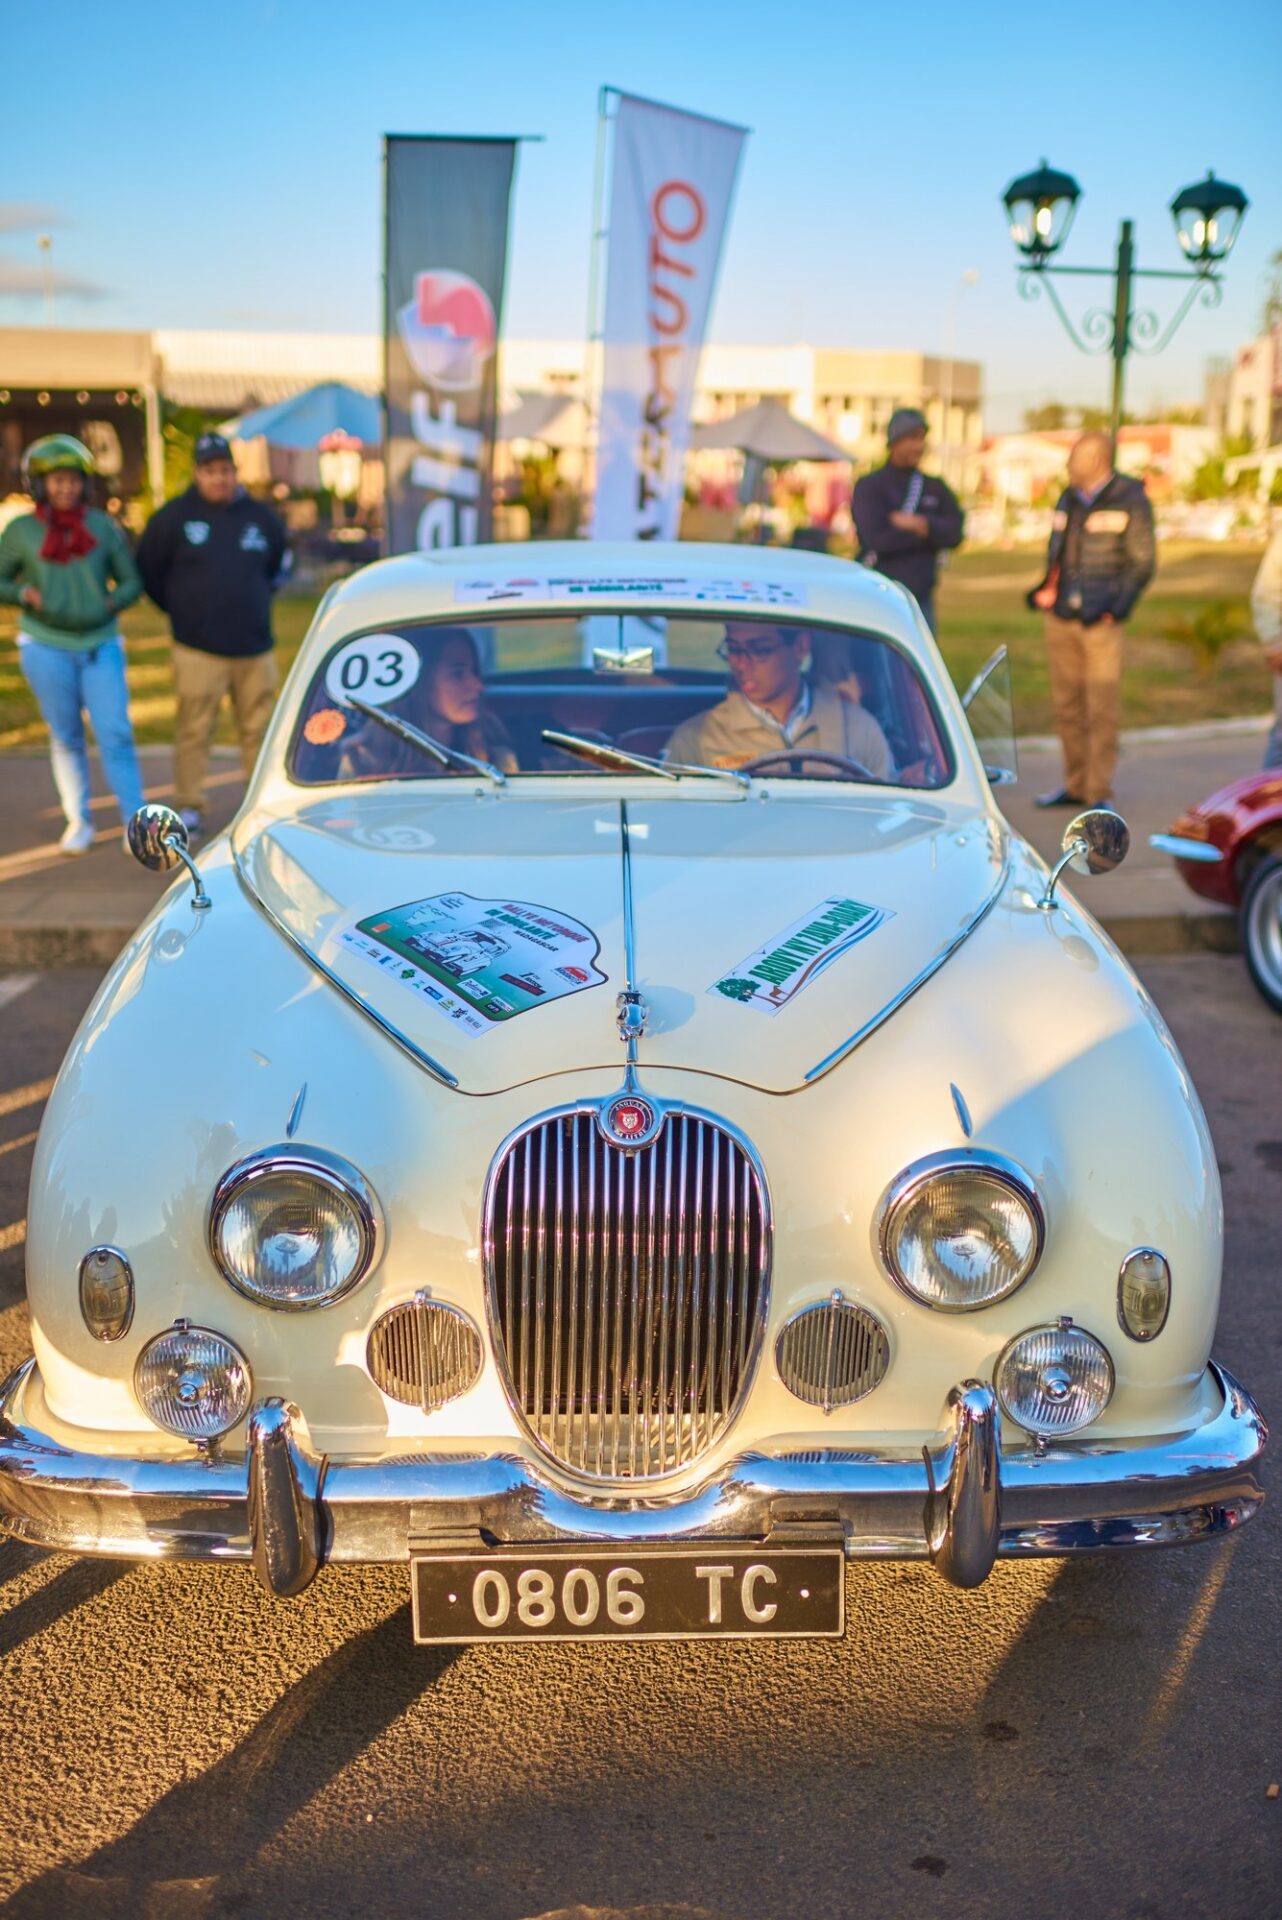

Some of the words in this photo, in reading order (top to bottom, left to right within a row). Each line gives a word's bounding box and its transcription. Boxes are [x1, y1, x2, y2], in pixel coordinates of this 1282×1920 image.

[411, 390, 483, 551] elf
[340, 651, 404, 690] 03
[513, 930, 559, 952] MADAGASCAR
[748, 948, 809, 985] AROVY
[782, 937, 822, 956] NY
[615, 1101, 643, 1111] JAGUAR
[473, 1567, 645, 1627] 0806
[695, 1565, 778, 1623] TC
